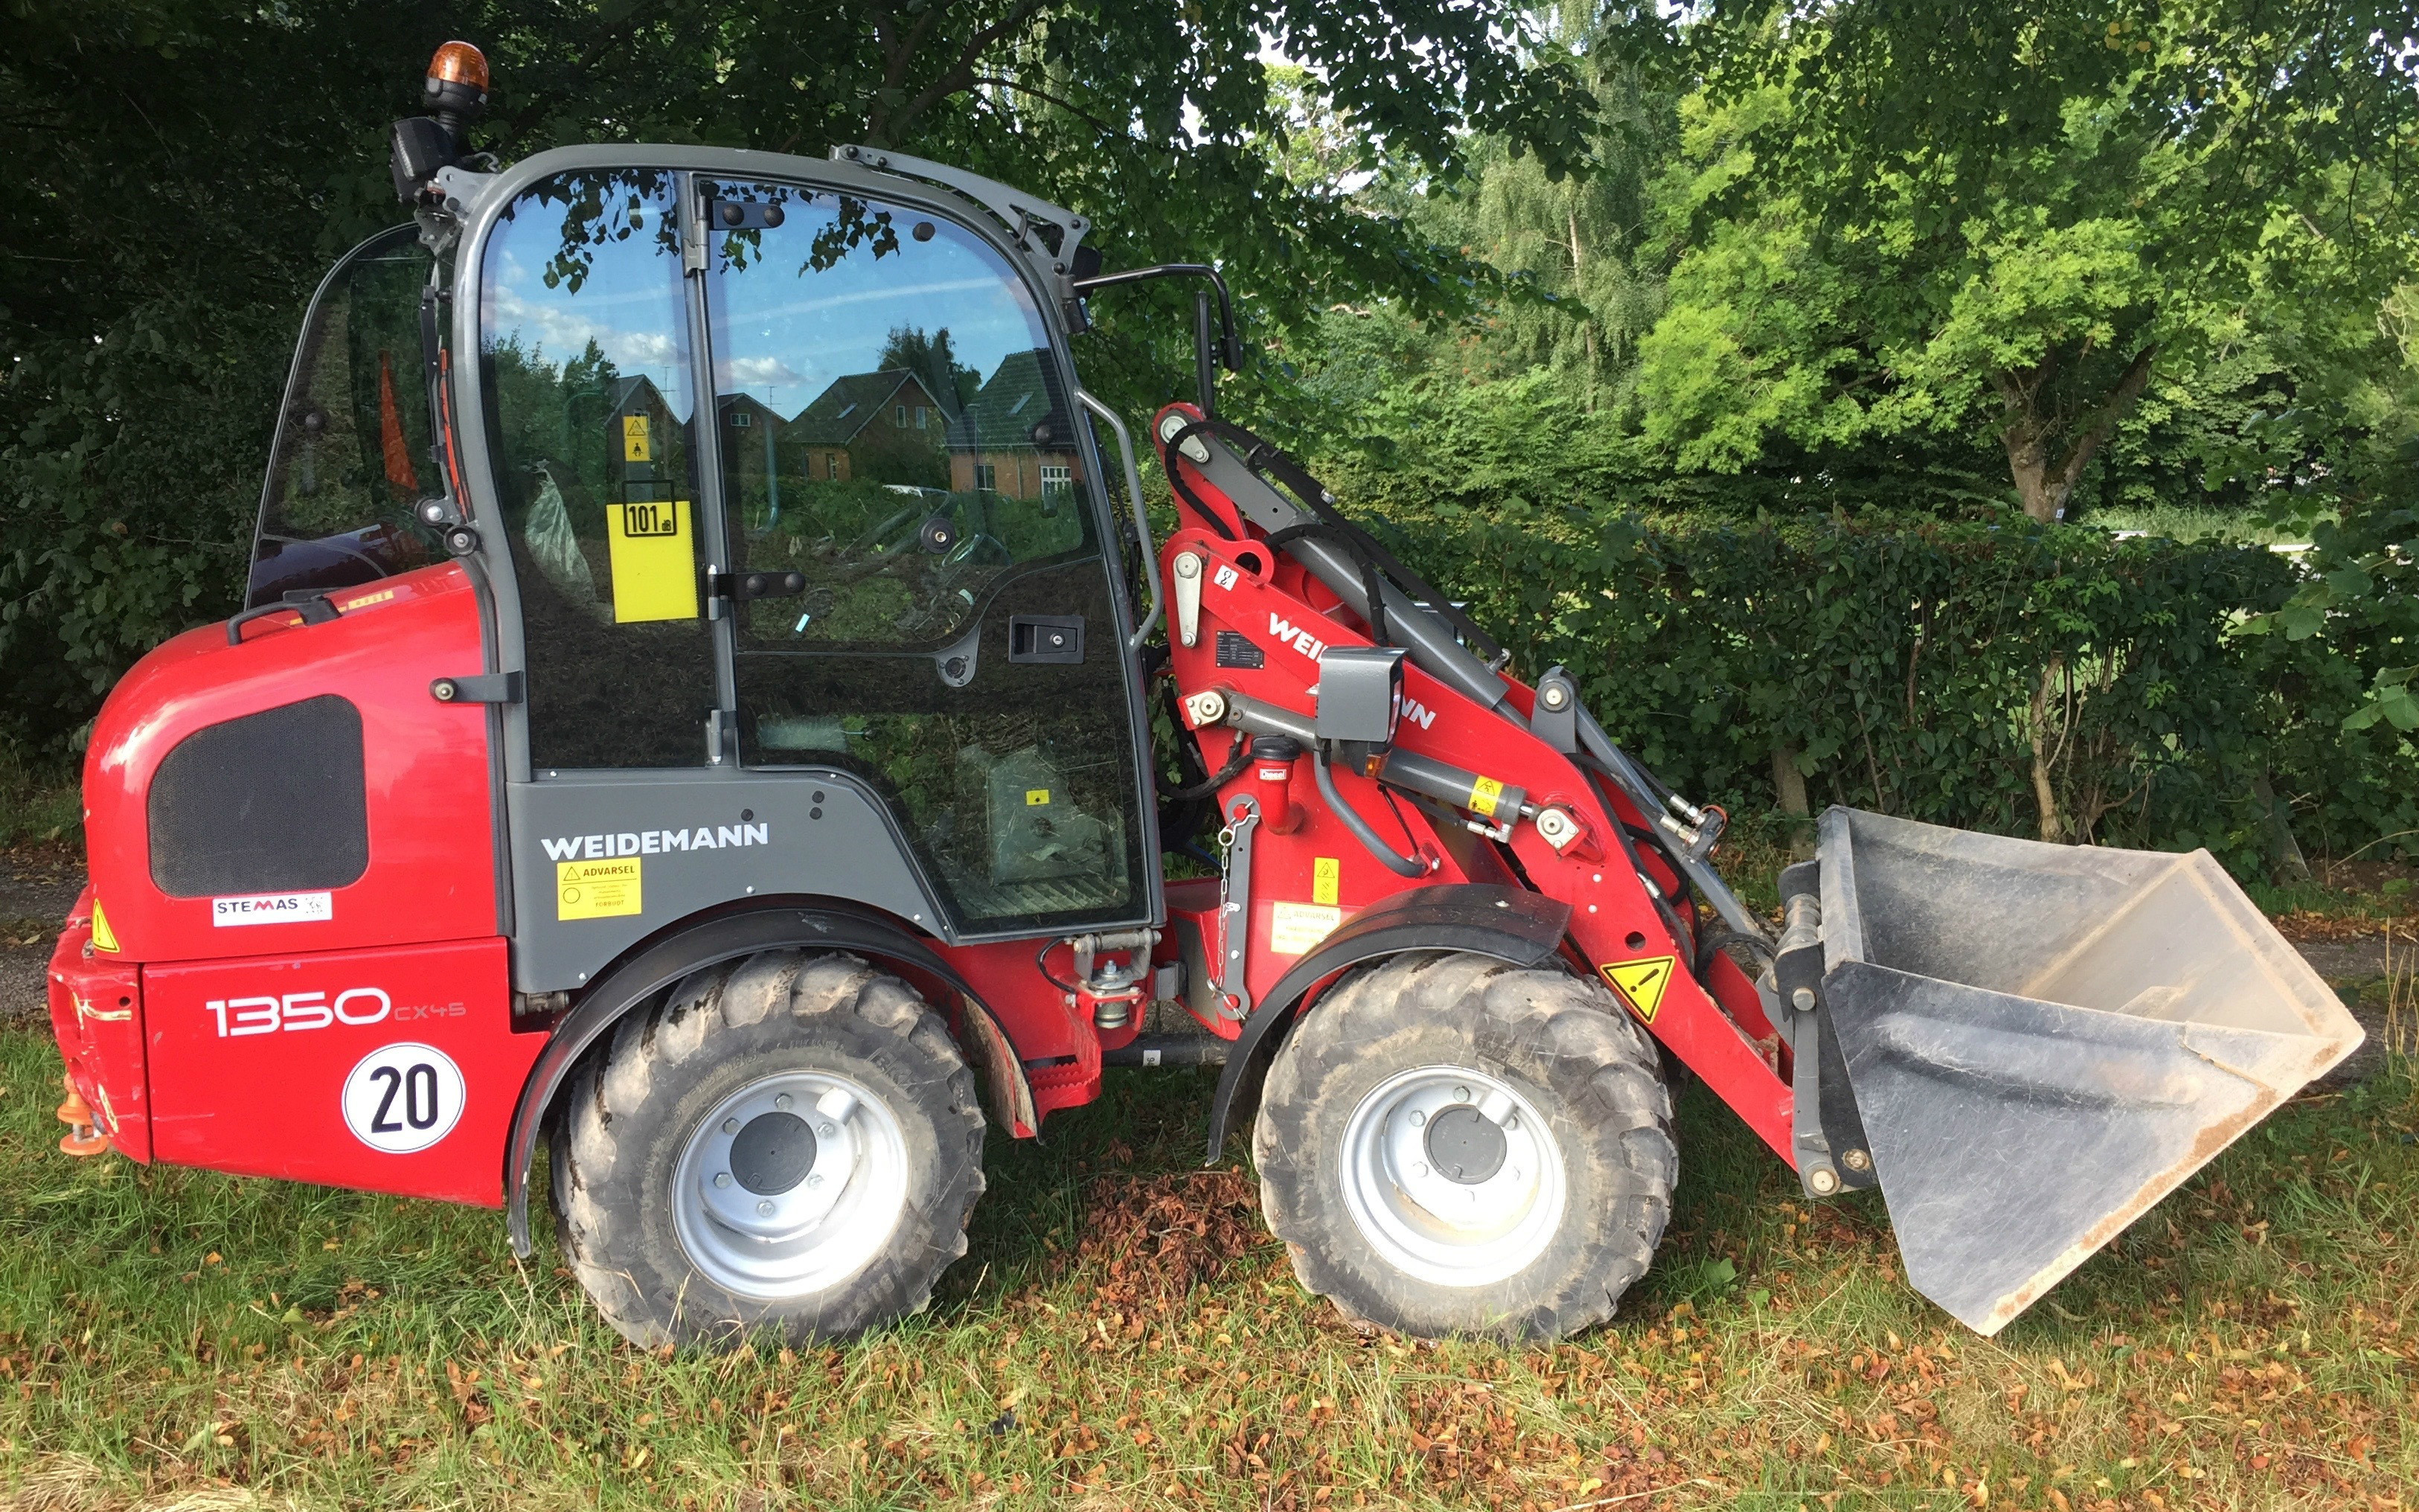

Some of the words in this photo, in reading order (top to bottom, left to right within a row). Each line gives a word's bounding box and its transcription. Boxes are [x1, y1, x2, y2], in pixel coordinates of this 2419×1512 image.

[629, 505, 658, 532] 101
[541, 823, 769, 861] WEIDEMANN
[583, 865, 635, 877] ADVARSEL
[217, 898, 298, 914] STEMAS
[205, 987, 391, 1038] 1350
[394, 1002, 467, 1022] CX45
[370, 1063, 438, 1133] 20
